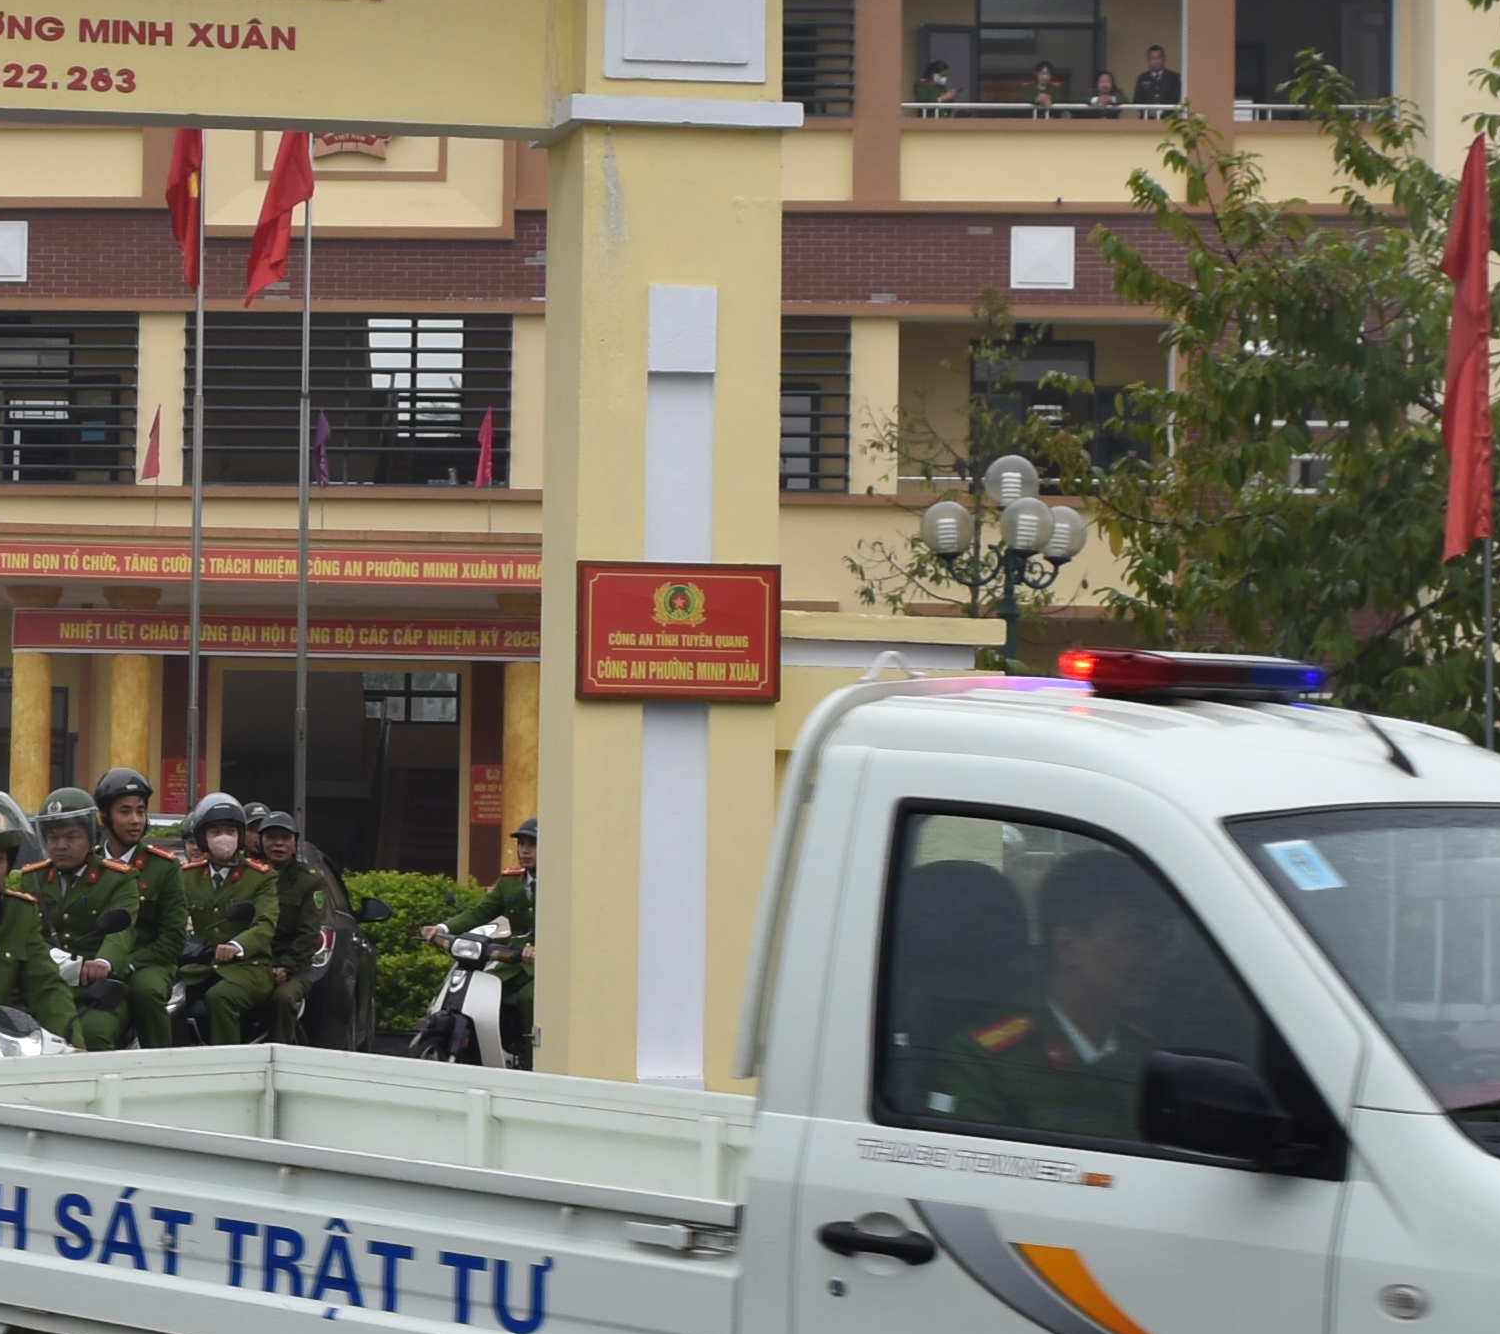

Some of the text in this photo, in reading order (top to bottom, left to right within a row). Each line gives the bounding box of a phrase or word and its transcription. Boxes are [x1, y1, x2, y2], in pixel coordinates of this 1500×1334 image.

[79, 18, 175, 47] MINH
[189, 17, 298, 51] XUÂN
[0, 553, 30, 570] TINH
[33, 553, 61, 574] GỌN
[63, 548, 80, 571] TỔ
[82, 552, 121, 574] CHỨC,
[124, 553, 159, 573] TĂNG
[162, 553, 206, 574] CƯỜG
[209, 555, 251, 574] TRÁCH
[307, 557, 340, 576] CÔNG
[344, 560, 363, 577] AN
[366, 558, 420, 578] PHƯỜNG
[423, 561, 459, 580] MINH
[462, 559, 498, 580] XUÂN
[502, 560, 514, 580] VÌ
[59, 620, 102, 644] NHIỆT
[105, 620, 136, 644] LIỆT
[140, 621, 179, 642] CHÀO
[231, 624, 257, 646] ĐẠI
[261, 623, 286, 647] HỘI
[290, 624, 330, 644] ĐNG
[335, 624, 355, 648] BỘ
[358, 625, 389, 645] CÁC
[393, 623, 423, 646] CẤP
[427, 626, 476, 650] NHIỆM
[480, 626, 499, 647] KỲ
[503, 630, 540, 647] 2025
[608, 630, 750, 649] CÔNG AN TỈNH TUYÊN QUANG
[597, 655, 760, 682] CÔNG AN PHƯỜNG MINH XUÂN
[54, 1187, 194, 1277] SÁT
[215, 1218, 414, 1321] TRẬT
